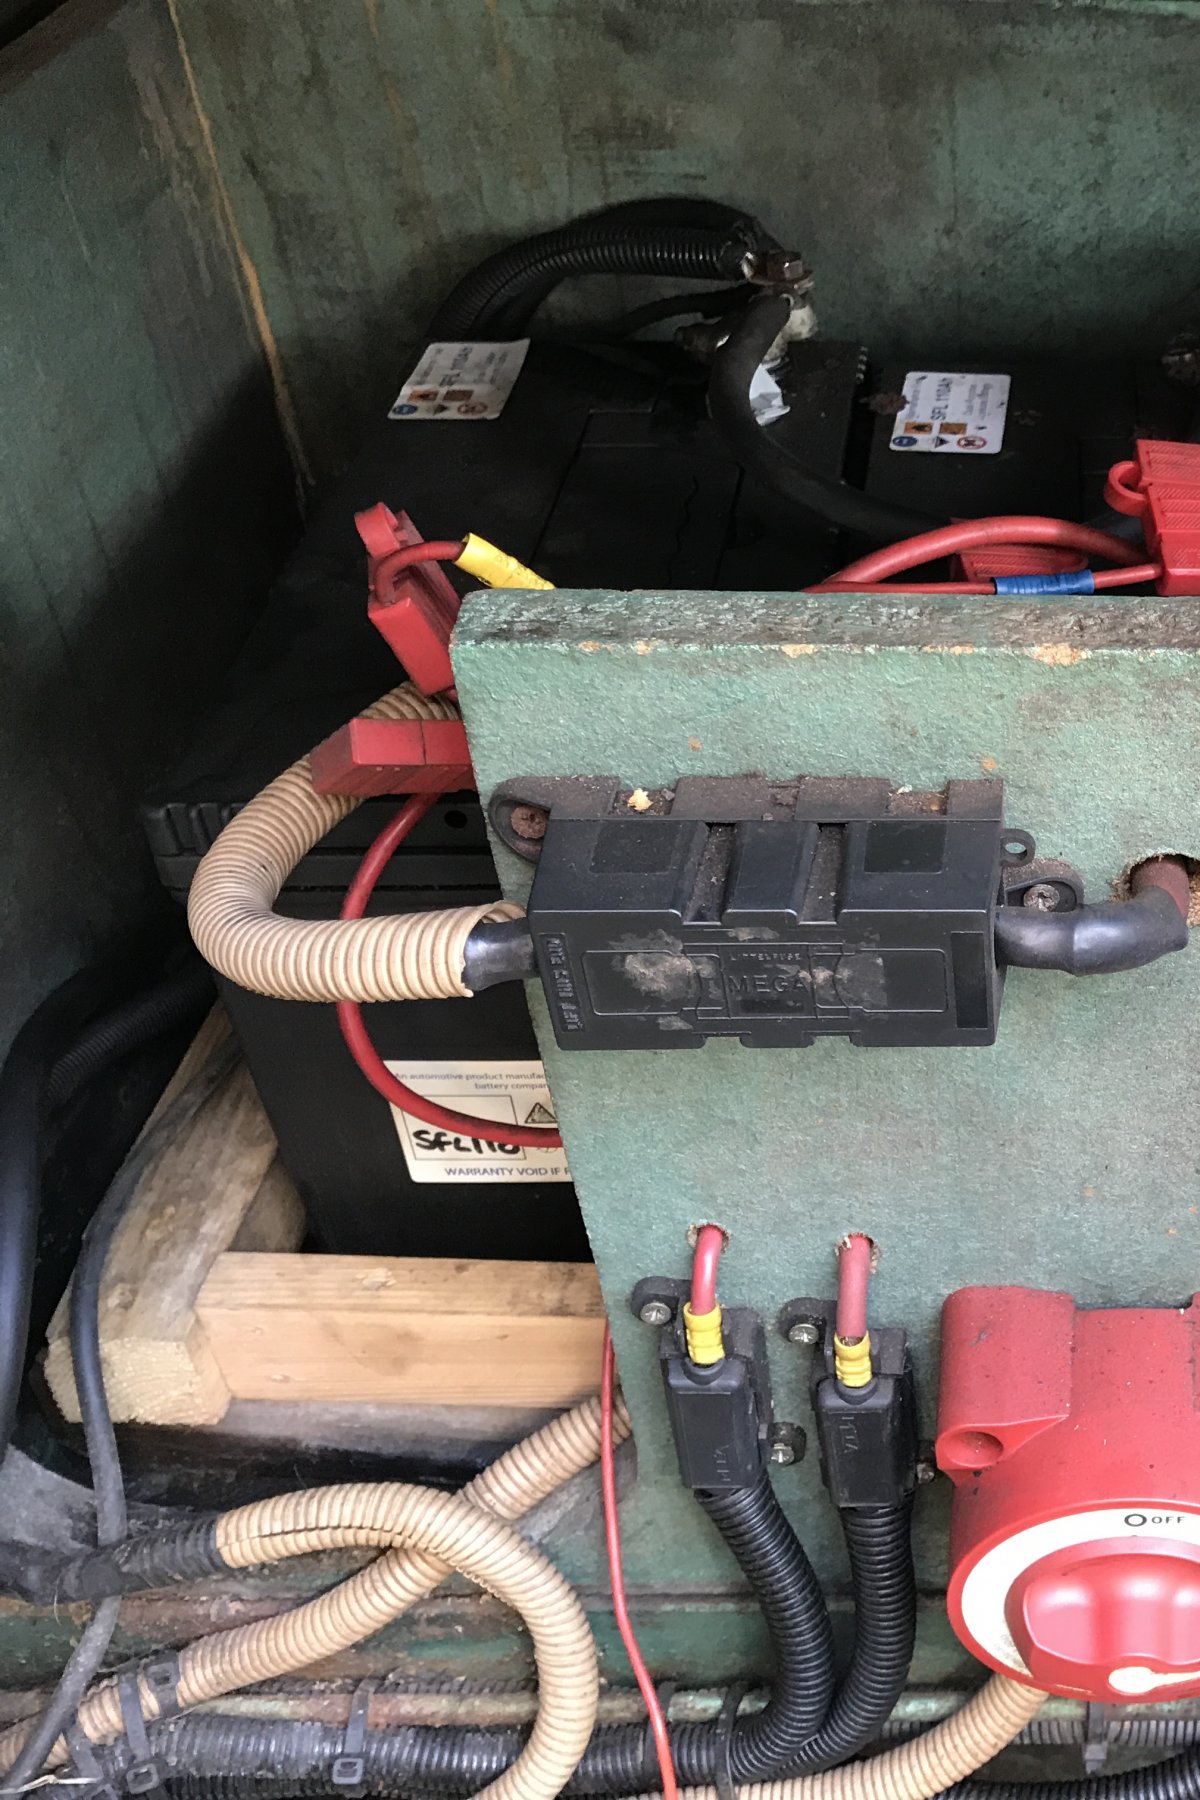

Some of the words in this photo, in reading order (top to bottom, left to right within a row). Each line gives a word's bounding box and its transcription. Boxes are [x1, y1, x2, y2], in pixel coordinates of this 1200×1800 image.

[728, 974, 812, 993] MEGA
[466, 1072, 503, 1081] product
[475, 1082, 509, 1091] battery
[445, 1167, 514, 1177] WARRANTY
[516, 1167, 548, 1177] VOID
[551, 1167, 561, 1176] IF
[1151, 1516, 1185, 1524] OFF
